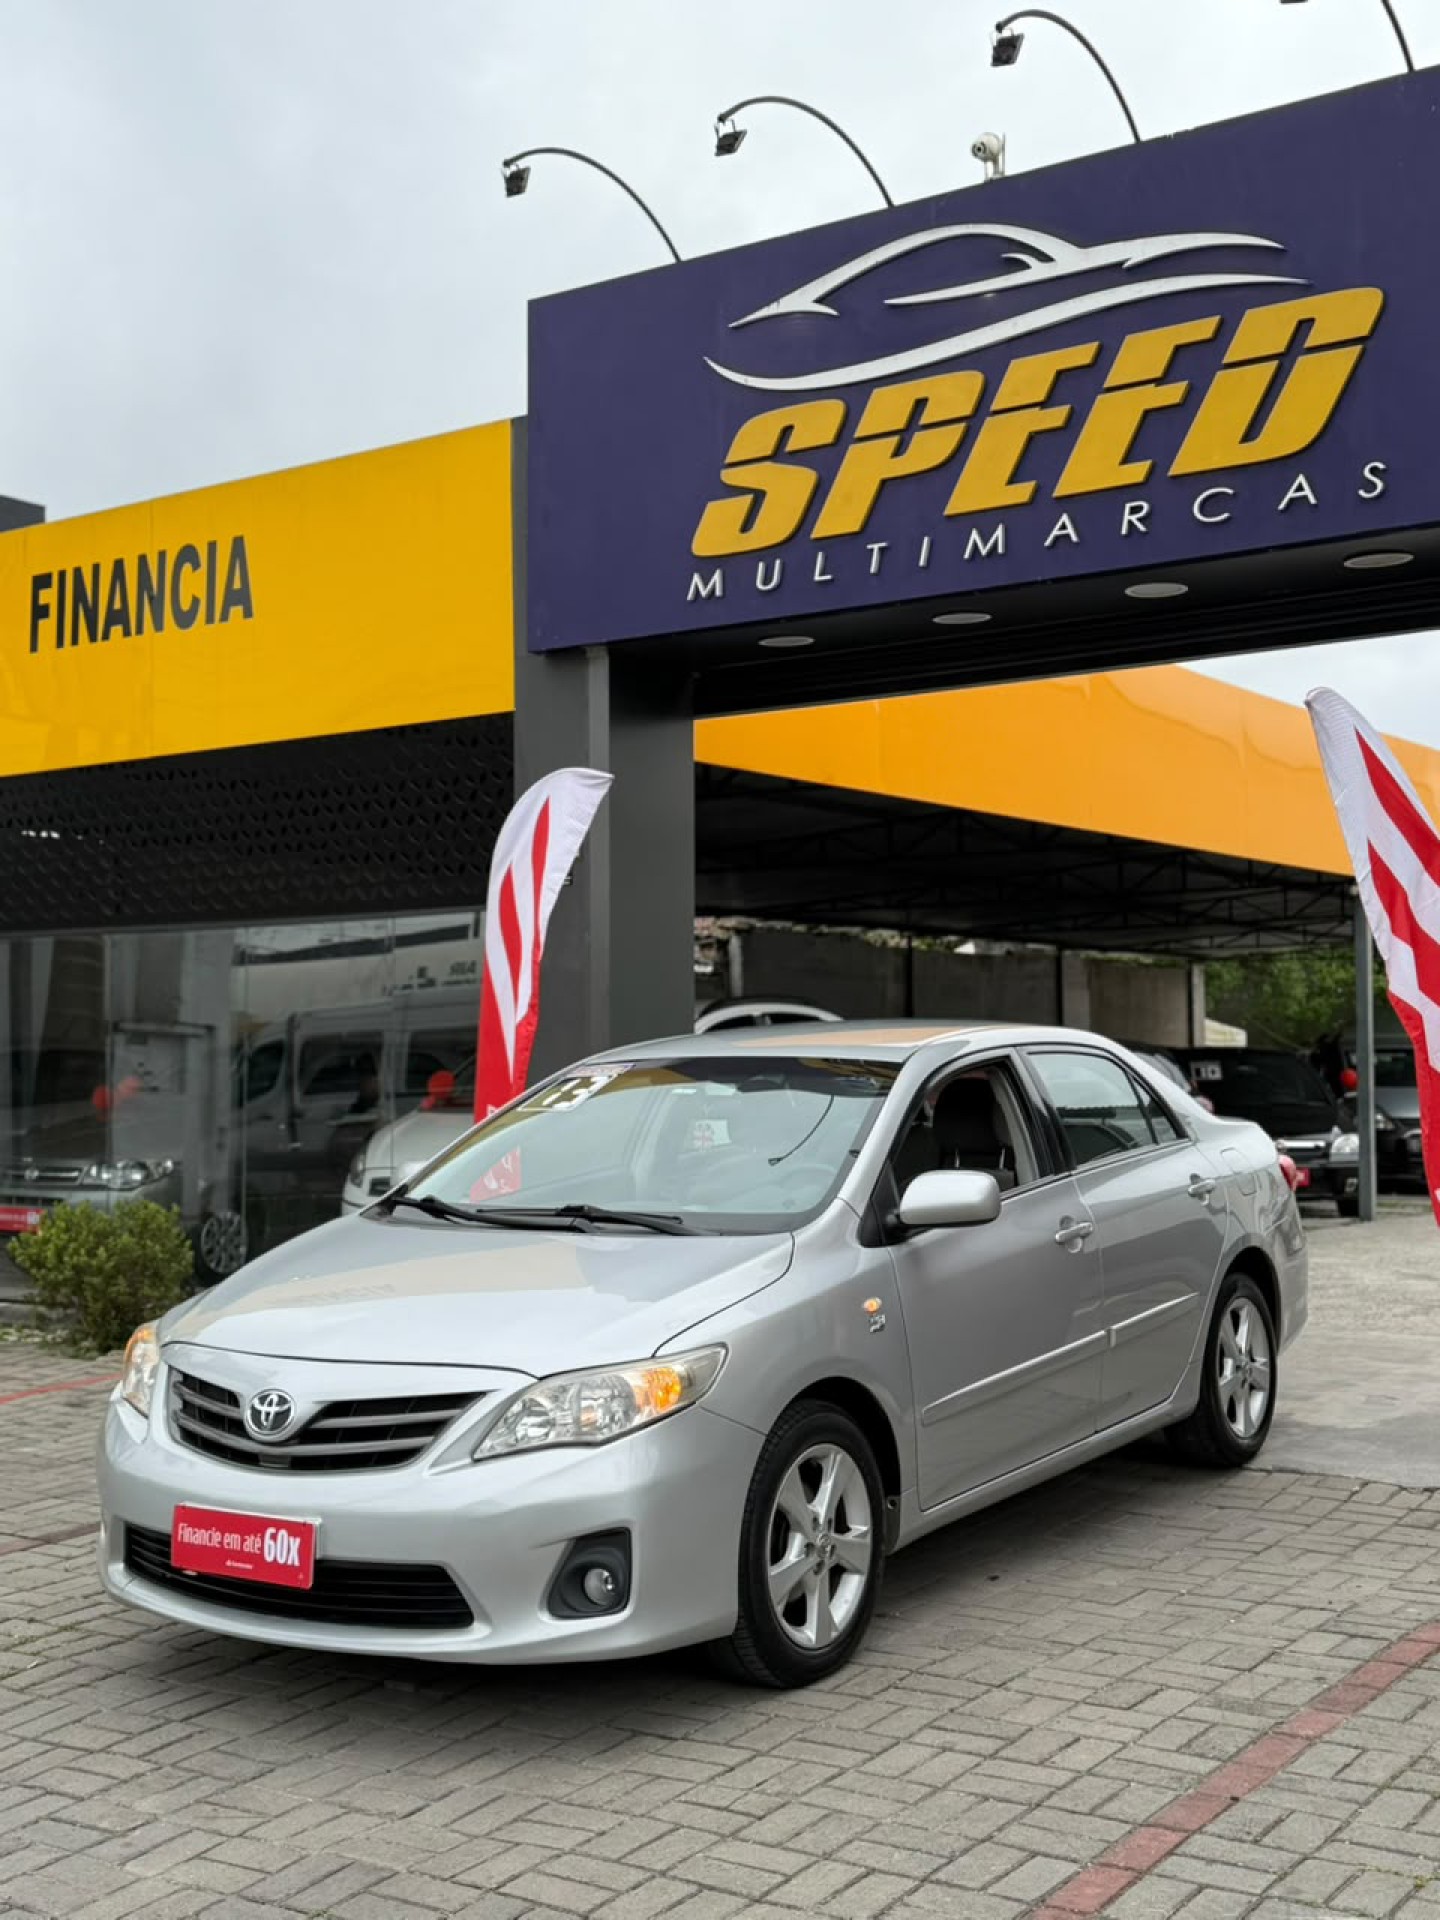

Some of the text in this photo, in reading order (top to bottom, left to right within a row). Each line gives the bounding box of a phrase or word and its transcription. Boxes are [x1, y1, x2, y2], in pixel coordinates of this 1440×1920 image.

[692, 287, 1384, 557] SPEED
[30, 535, 253, 653] FINANCIA
[686, 461, 1387, 602] MULTIMARCAS
[178, 1523, 221, 1549] Financie
[223, 1532, 240, 1551] em
[243, 1533, 262, 1554] até
[263, 1526, 301, 1567] 60x
